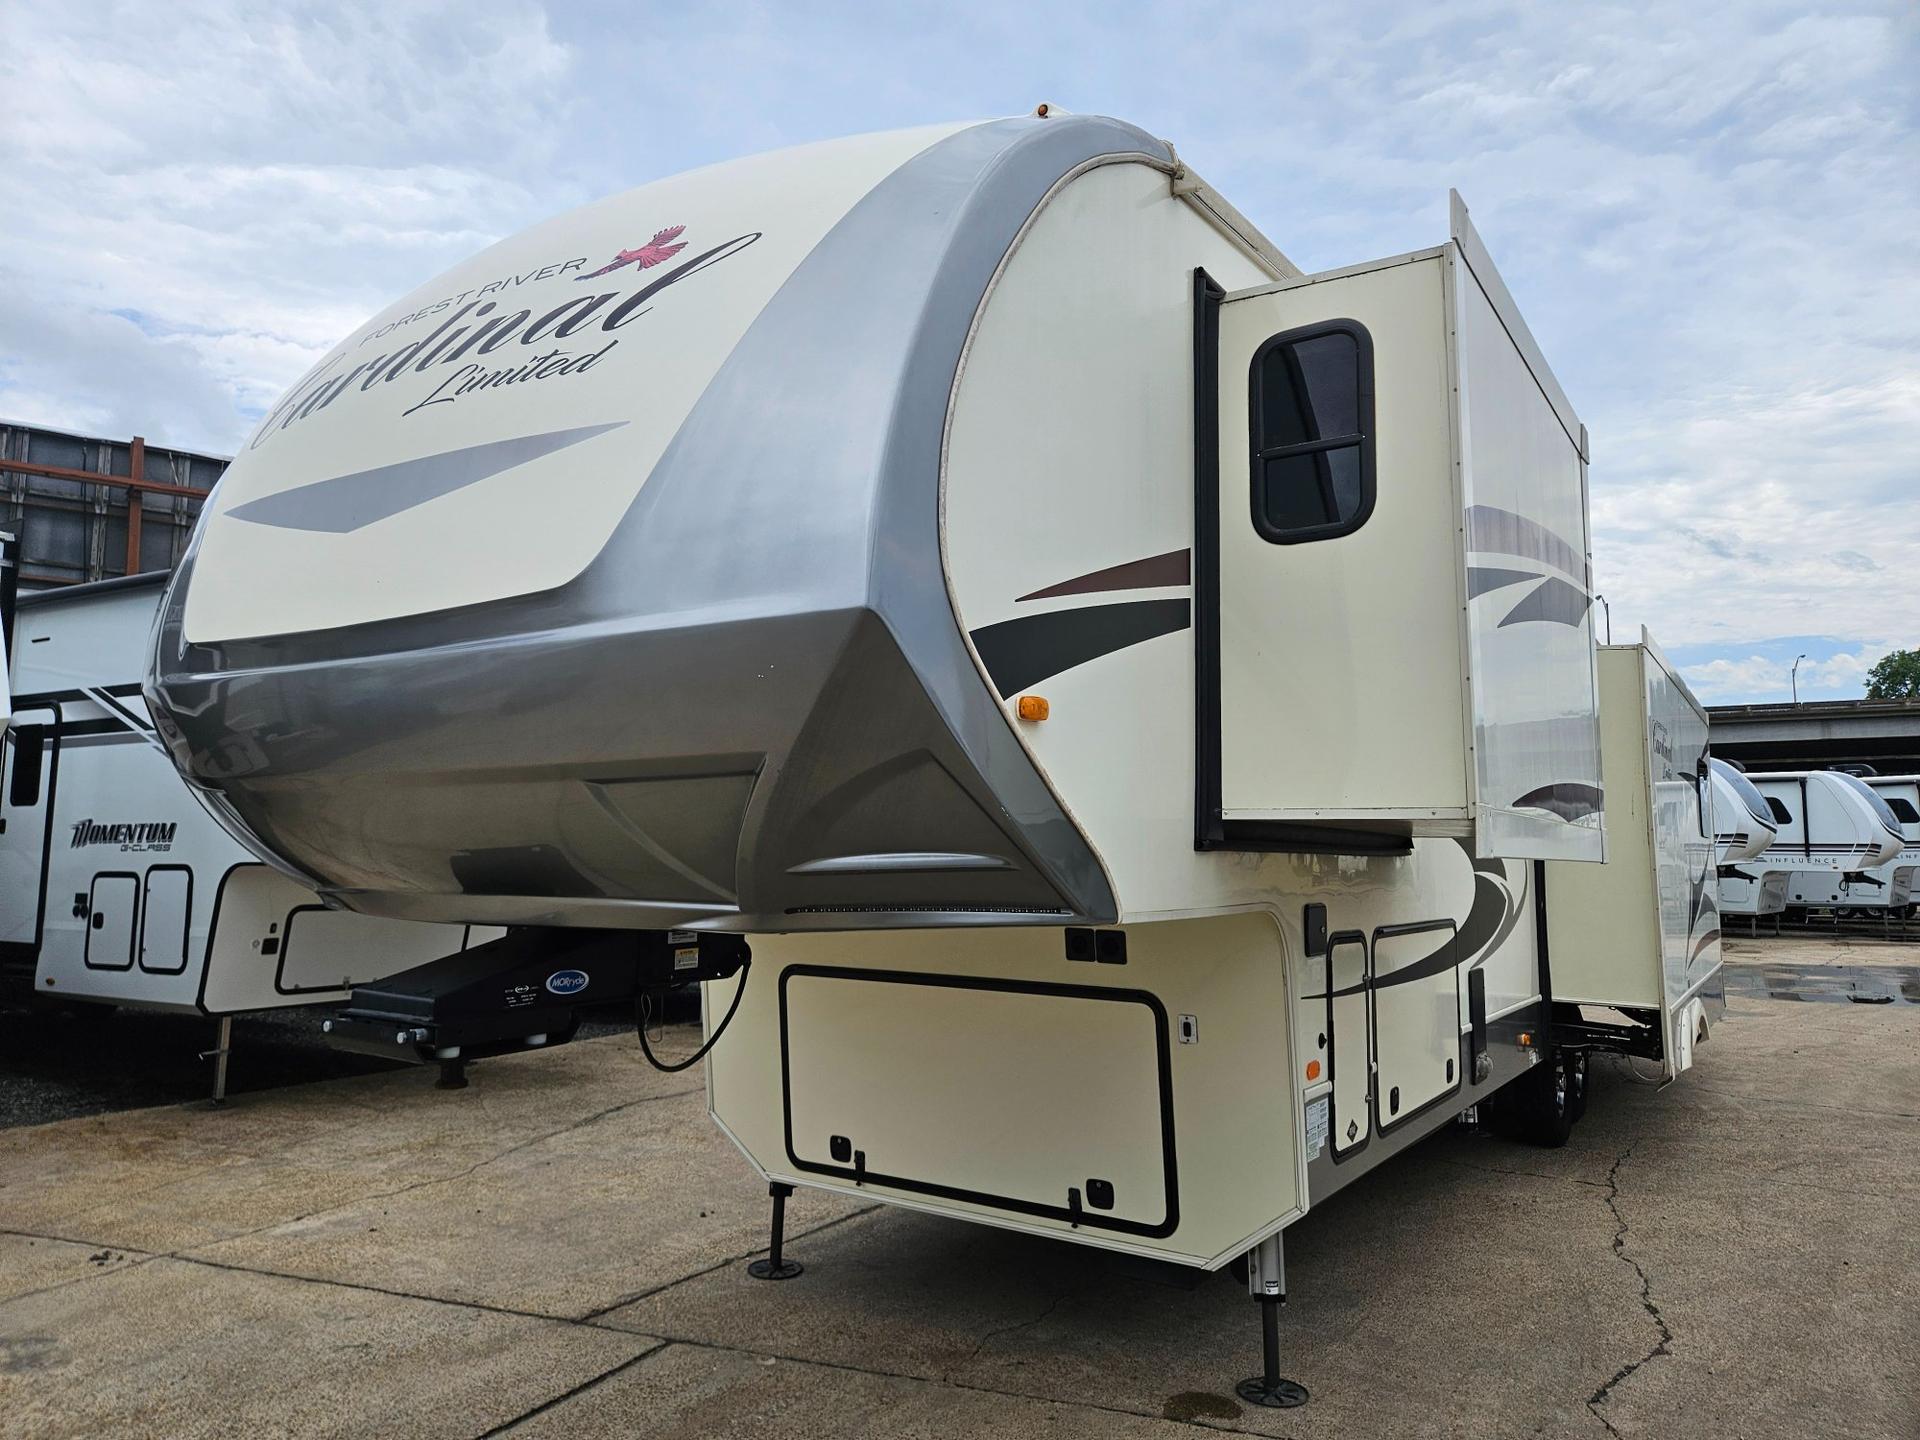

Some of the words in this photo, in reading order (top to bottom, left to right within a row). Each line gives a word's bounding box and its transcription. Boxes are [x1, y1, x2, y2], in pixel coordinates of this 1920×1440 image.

[251, 231, 762, 450] Cardinal
[359, 289, 475, 347] FOREST
[477, 257, 587, 297] RIVER
[402, 340, 619, 417] Limited
[70, 818, 178, 849] MOMENTUM
[120, 843, 172, 852] G-CLASS
